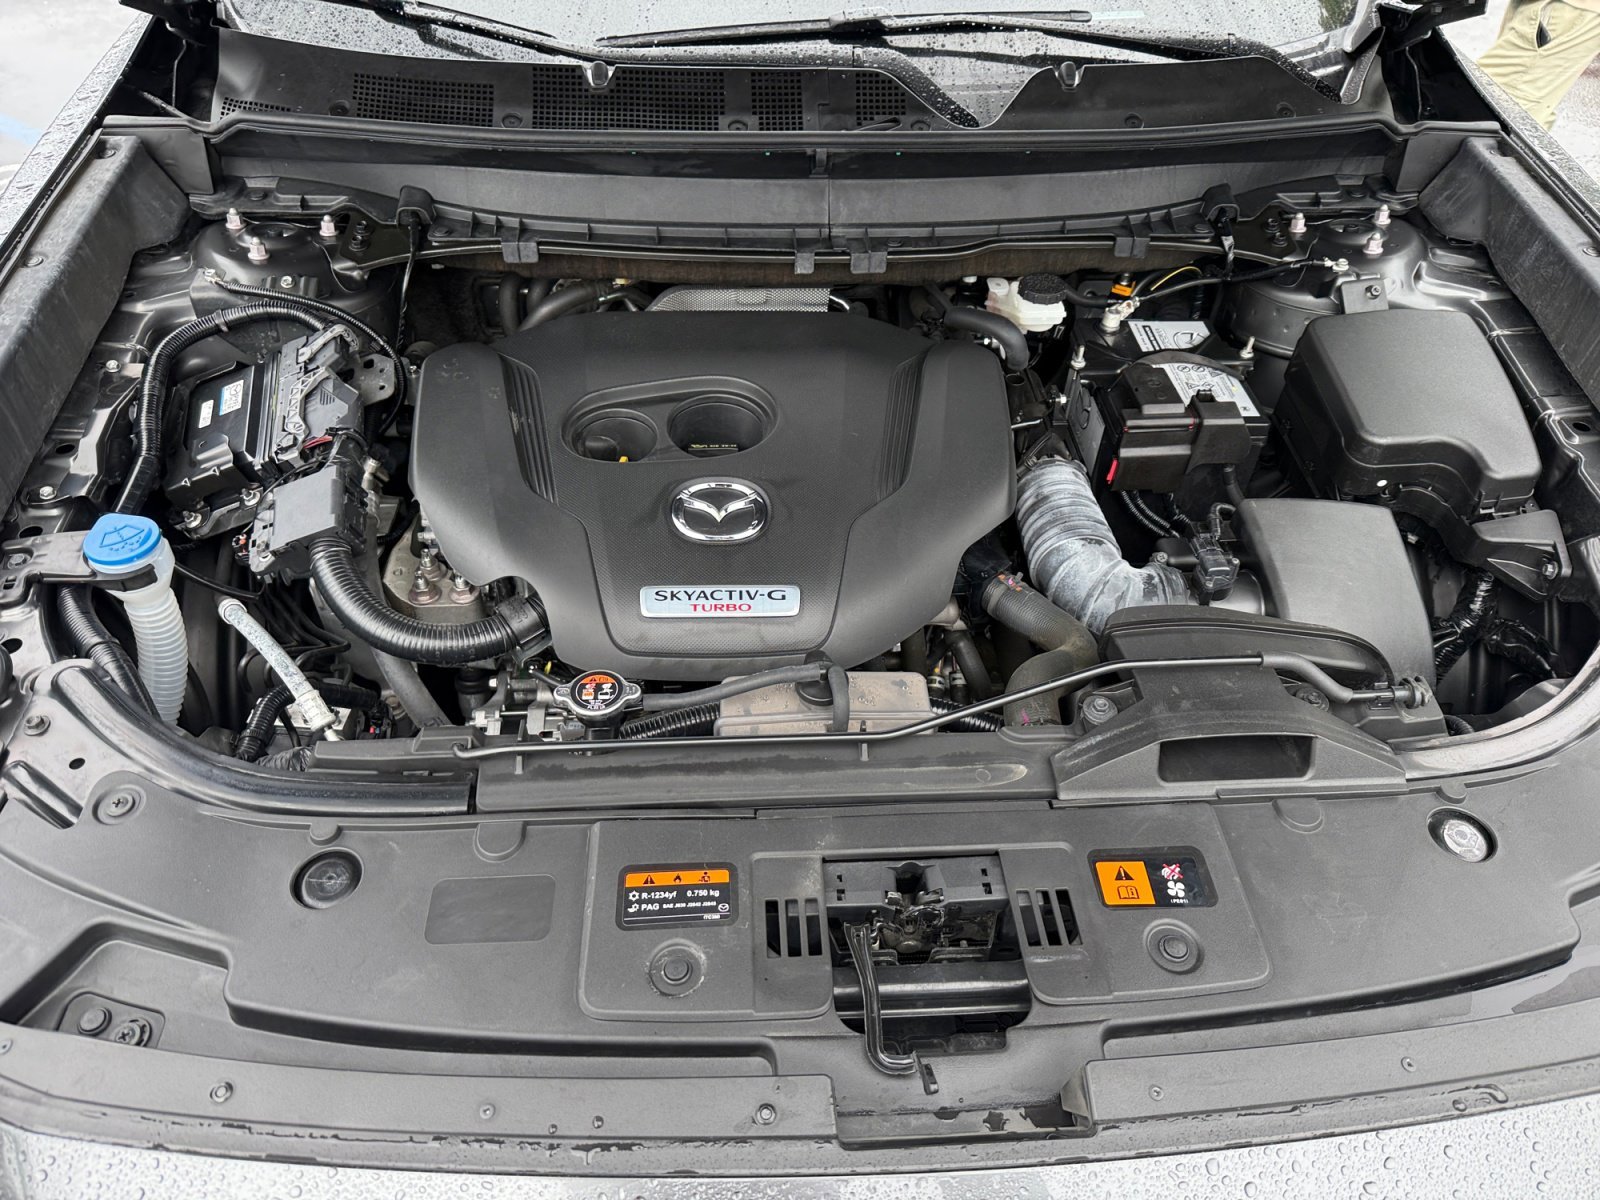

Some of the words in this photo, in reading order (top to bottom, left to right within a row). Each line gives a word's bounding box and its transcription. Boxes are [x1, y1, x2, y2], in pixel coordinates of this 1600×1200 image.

[654, 589, 786, 601] SKYACTIV-G
[690, 604, 752, 613] TURBO
[641, 891, 677, 900] R-1234yf
[709, 889, 720, 898] kg
[641, 903, 660, 911] PAG
